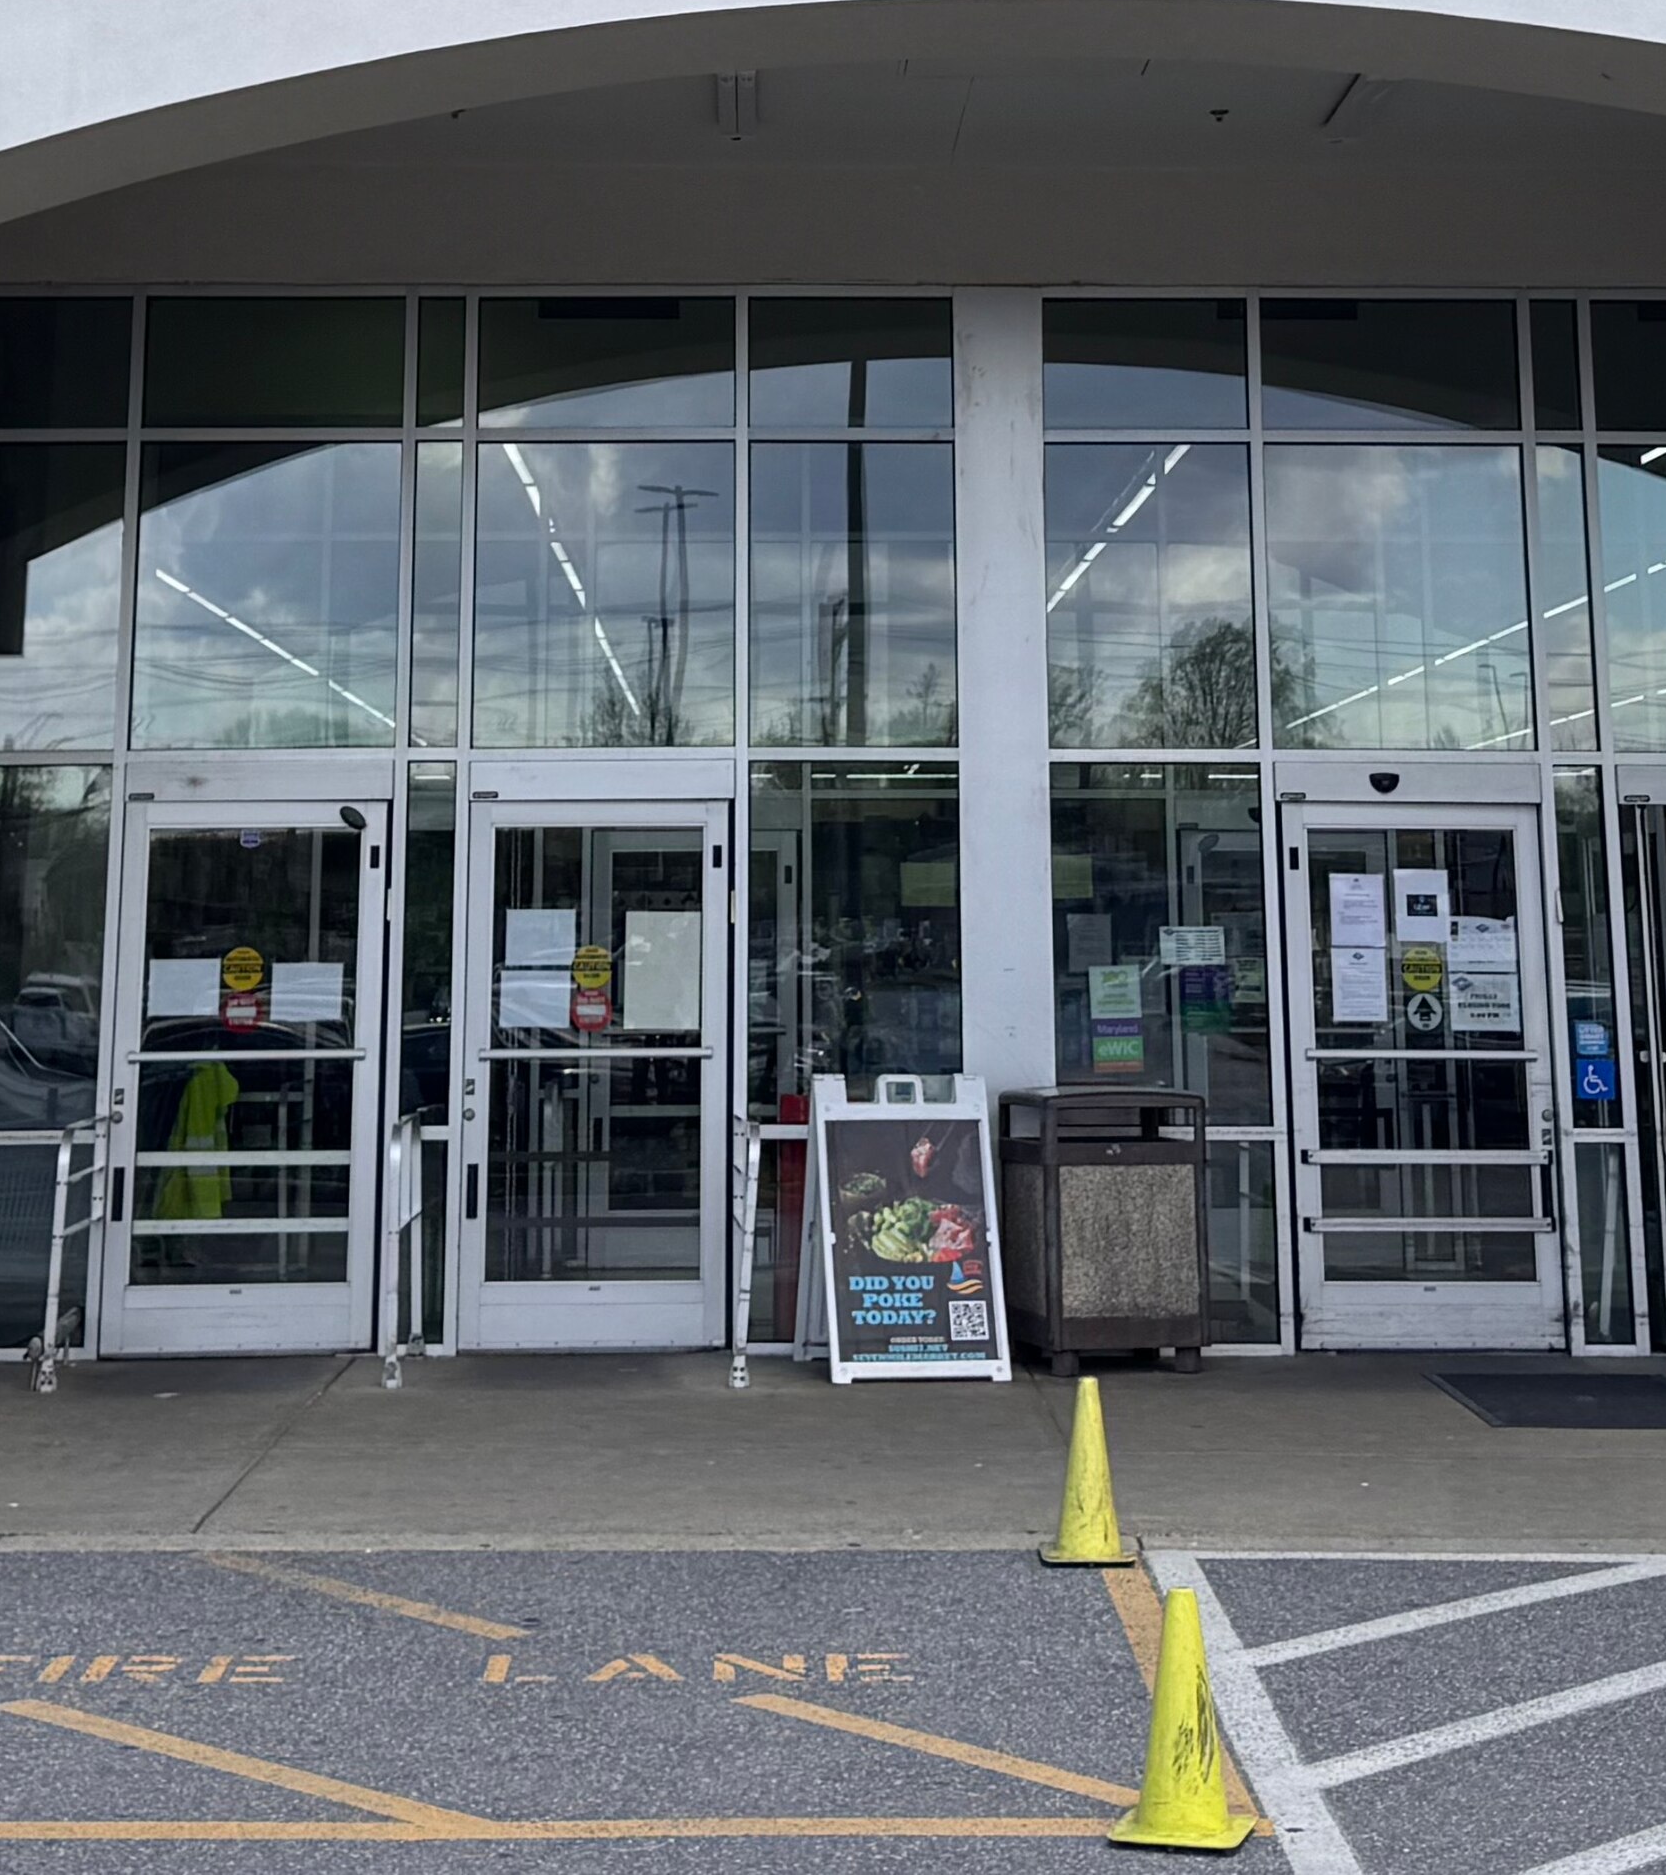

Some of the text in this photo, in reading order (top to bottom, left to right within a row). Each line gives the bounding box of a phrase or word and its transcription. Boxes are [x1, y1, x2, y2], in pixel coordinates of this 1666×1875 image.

[1099, 1040, 1138, 1056] eWIC
[848, 1275, 935, 1291] DID YOU
[862, 1293, 923, 1308] POKE
[851, 1309, 937, 1325] TODAY?
[480, 1650, 919, 1686] LANE
